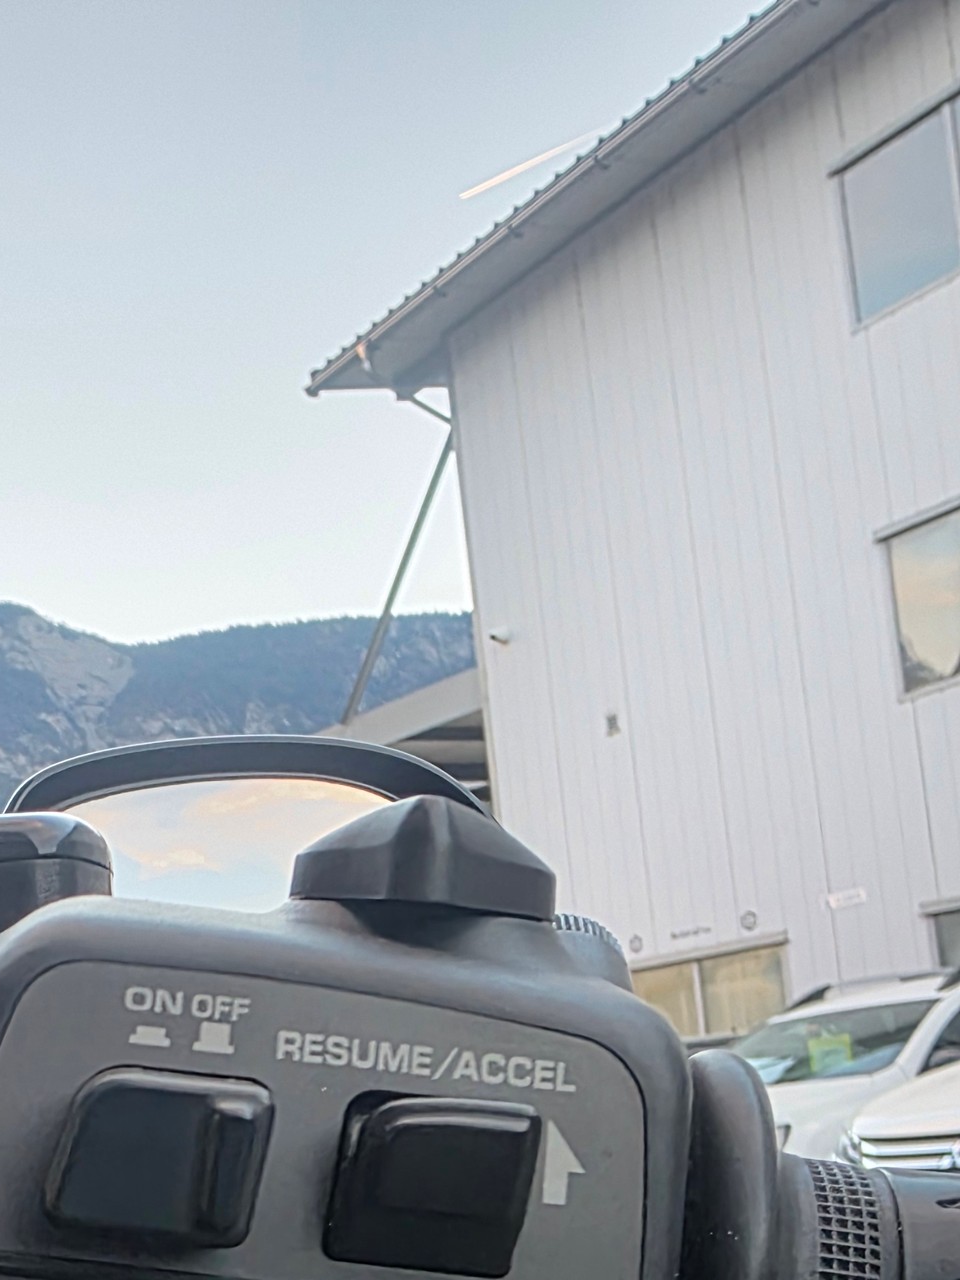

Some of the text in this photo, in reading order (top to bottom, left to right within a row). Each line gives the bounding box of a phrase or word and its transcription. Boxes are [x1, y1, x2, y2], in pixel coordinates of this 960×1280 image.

[124, 986, 251, 1021] ON OFF
[276, 1030, 577, 1093] RESUME/ACCEL
